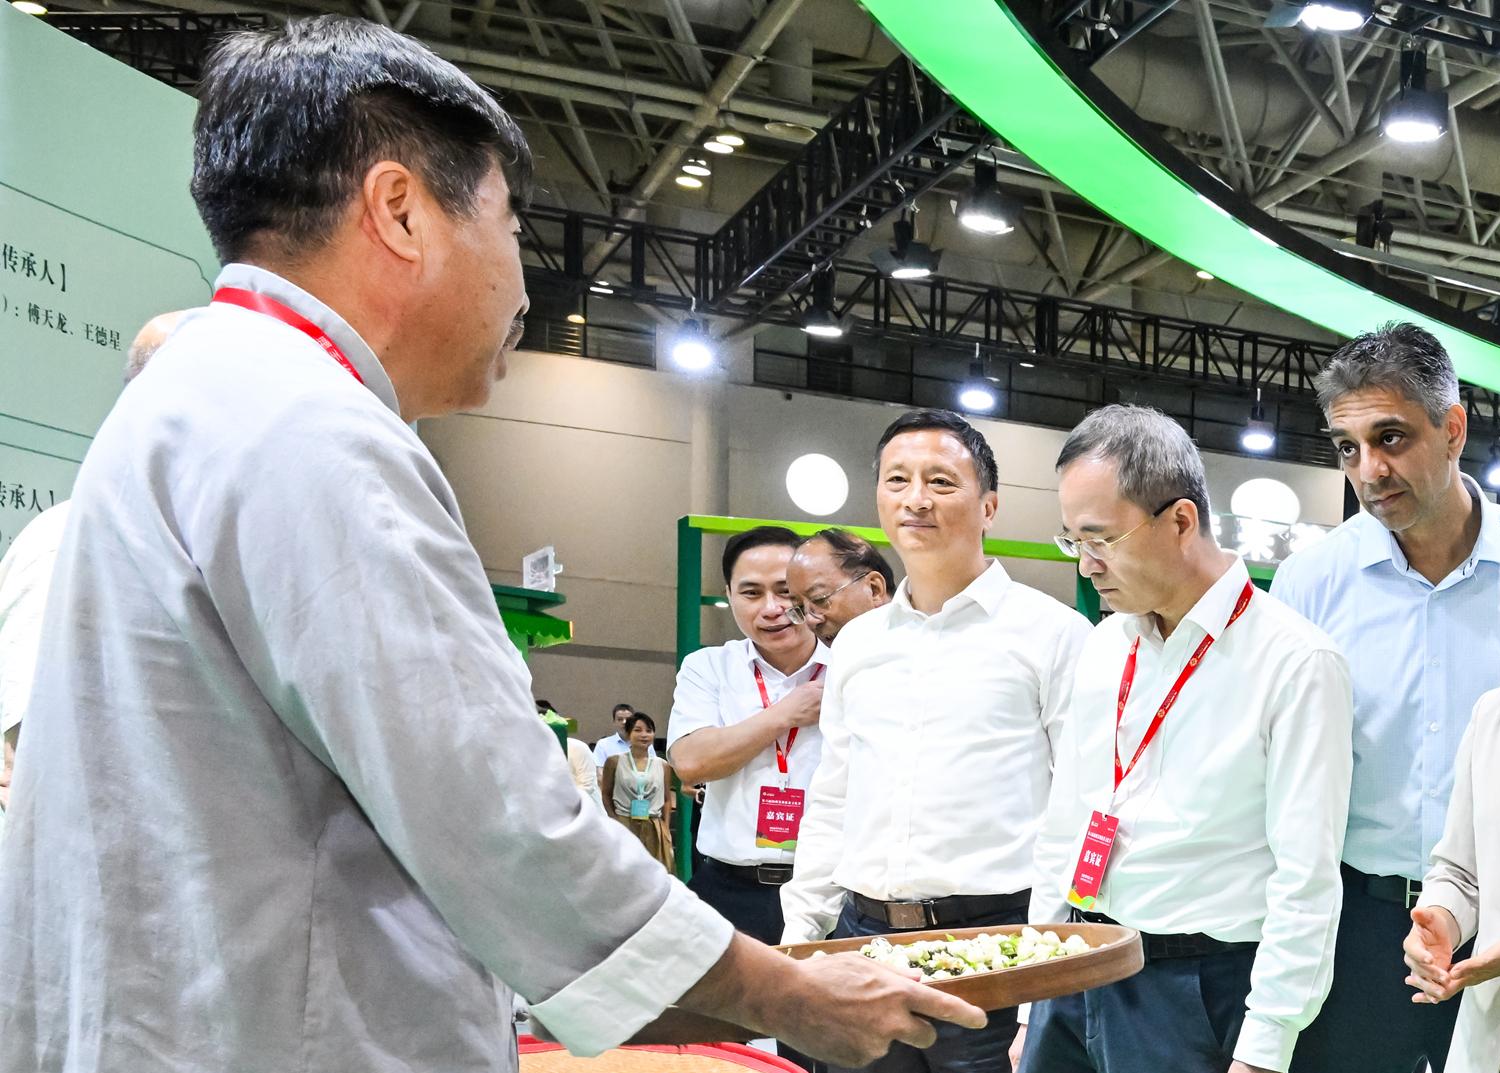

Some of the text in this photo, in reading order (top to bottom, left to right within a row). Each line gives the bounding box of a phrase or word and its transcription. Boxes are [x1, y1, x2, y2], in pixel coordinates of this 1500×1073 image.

[2, 243, 66, 292] 传承人】
[766, 811, 795, 822] 嘉宾证
[1083, 849, 1103, 867] 嘉宾证
